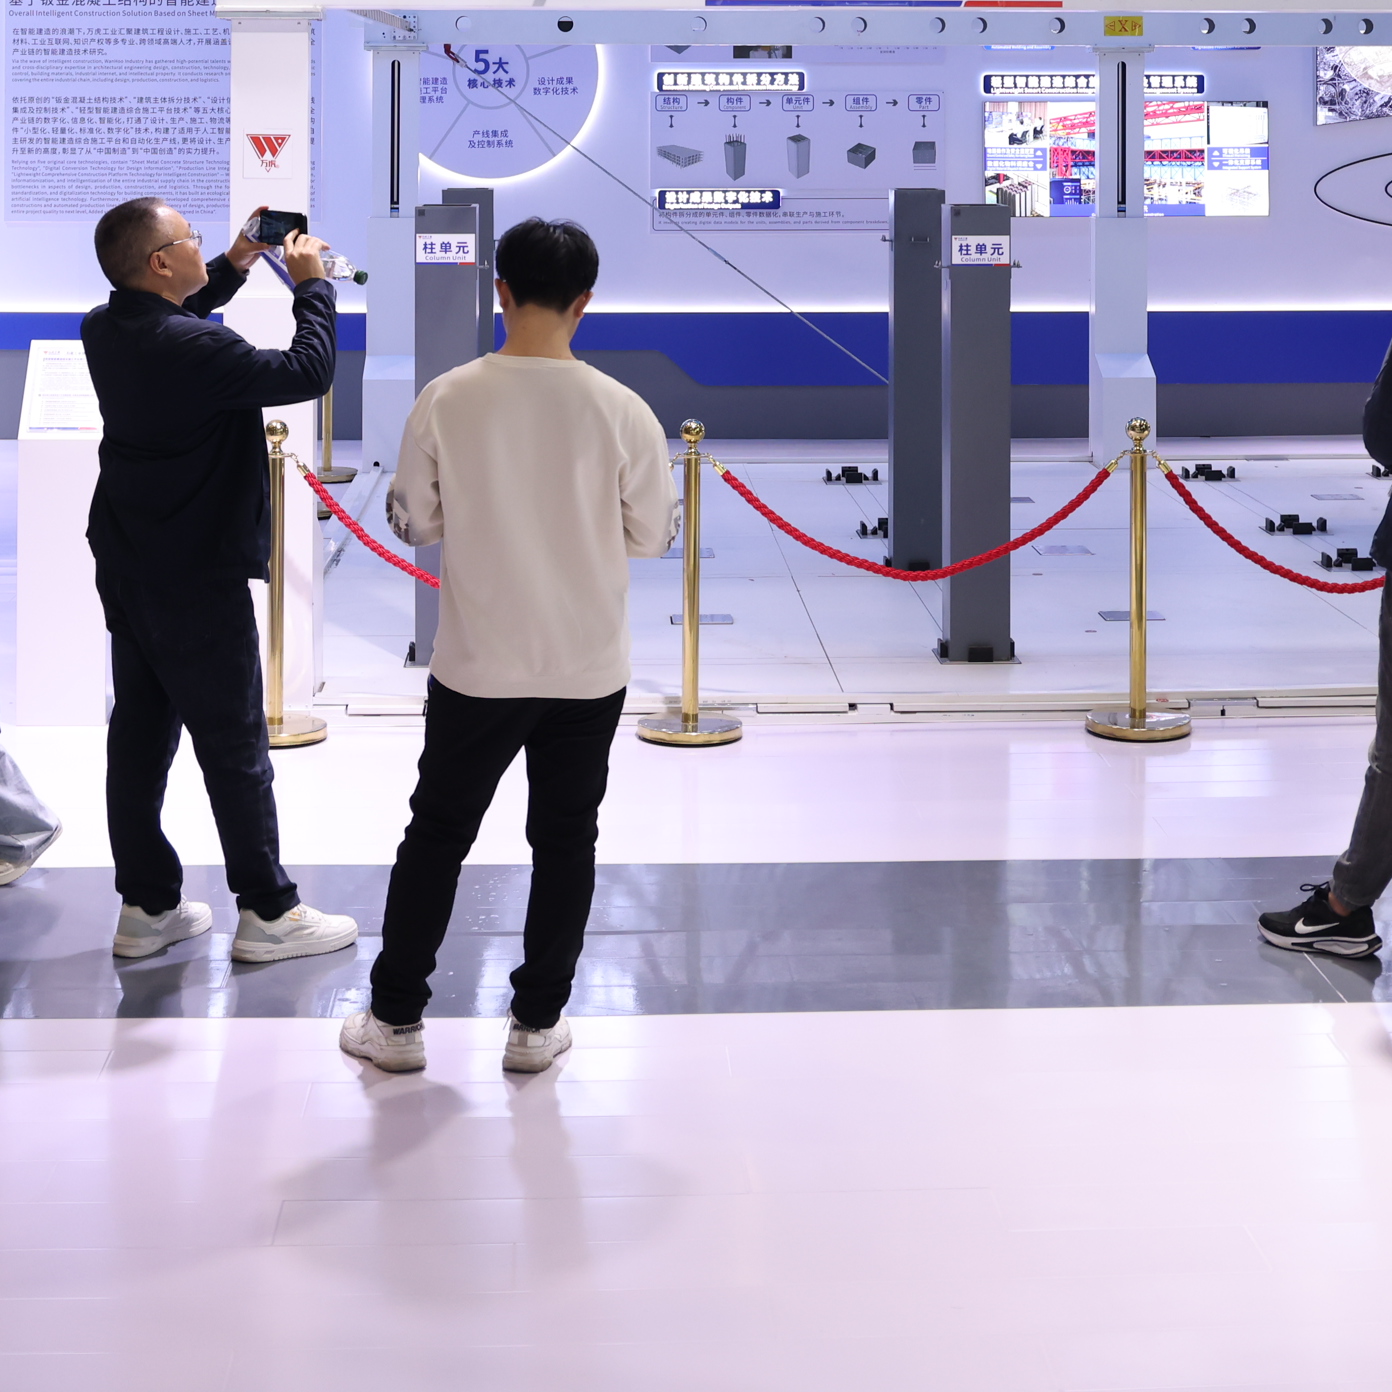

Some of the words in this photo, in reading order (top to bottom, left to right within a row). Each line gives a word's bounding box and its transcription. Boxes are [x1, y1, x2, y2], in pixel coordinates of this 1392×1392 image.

[36, 10, 73, 19] Intelligent
[474, 49, 510, 75] 5大
[420, 76, 448, 86] 能建造
[467, 77, 516, 90] 核心技术
[537, 76, 574, 85] 设计成果
[420, 86, 448, 95] 工平台
[533, 86, 579, 96] 数字化技术
[663, 96, 680, 105] 结构
[726, 96, 744, 105] 构件
[785, 96, 811, 106] 单元件
[852, 96, 870, 106] 组件
[915, 96, 933, 105] 零件
[472, 129, 509, 139] 产线集成
[468, 139, 514, 149] 及控制系统
[422, 241, 470, 254] 柱单元
[958, 243, 1004, 256] 柱单元
